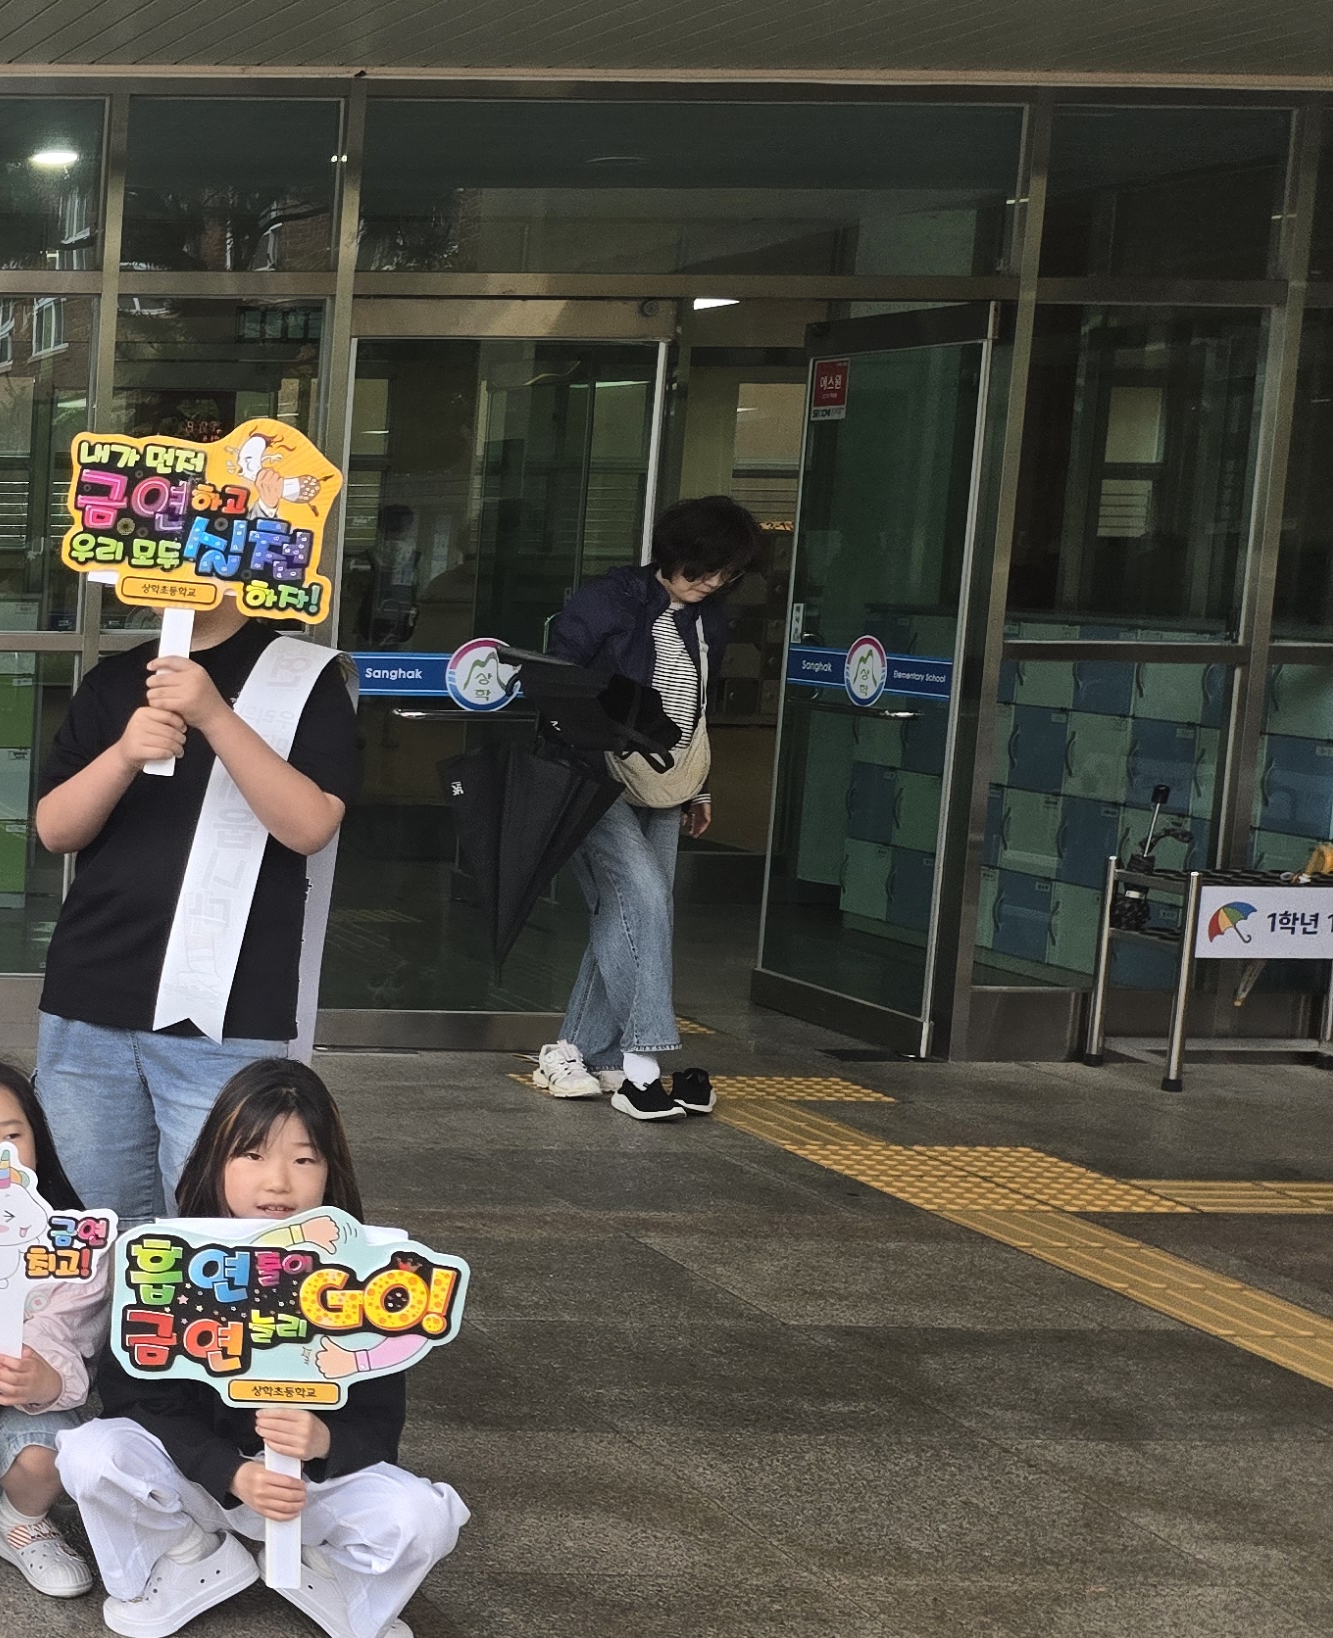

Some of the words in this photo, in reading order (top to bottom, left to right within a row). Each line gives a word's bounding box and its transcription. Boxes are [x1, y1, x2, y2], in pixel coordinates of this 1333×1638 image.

[820, 375, 842, 391] 에스원
[80, 441, 140, 469] 내가
[144, 444, 207, 473] 먼저
[76, 468, 251, 533] 금연하고
[70, 532, 125, 563] 우리
[130, 538, 182, 572] 모두
[182, 515, 315, 582] 실천
[244, 579, 323, 615] 하자!
[365, 667, 423, 682] Sanghak
[802, 660, 832, 672] Sanghak
[893, 670, 925, 682] Elementary
[925, 673, 947, 683] School
[1267, 911, 1319, 935] 1학년
[49, 1215, 110, 1248] 금연
[23, 1245, 93, 1281] 최고!
[298, 1266, 457, 1335] GO!
[251, 1384, 317, 1398] 상학초등학교
